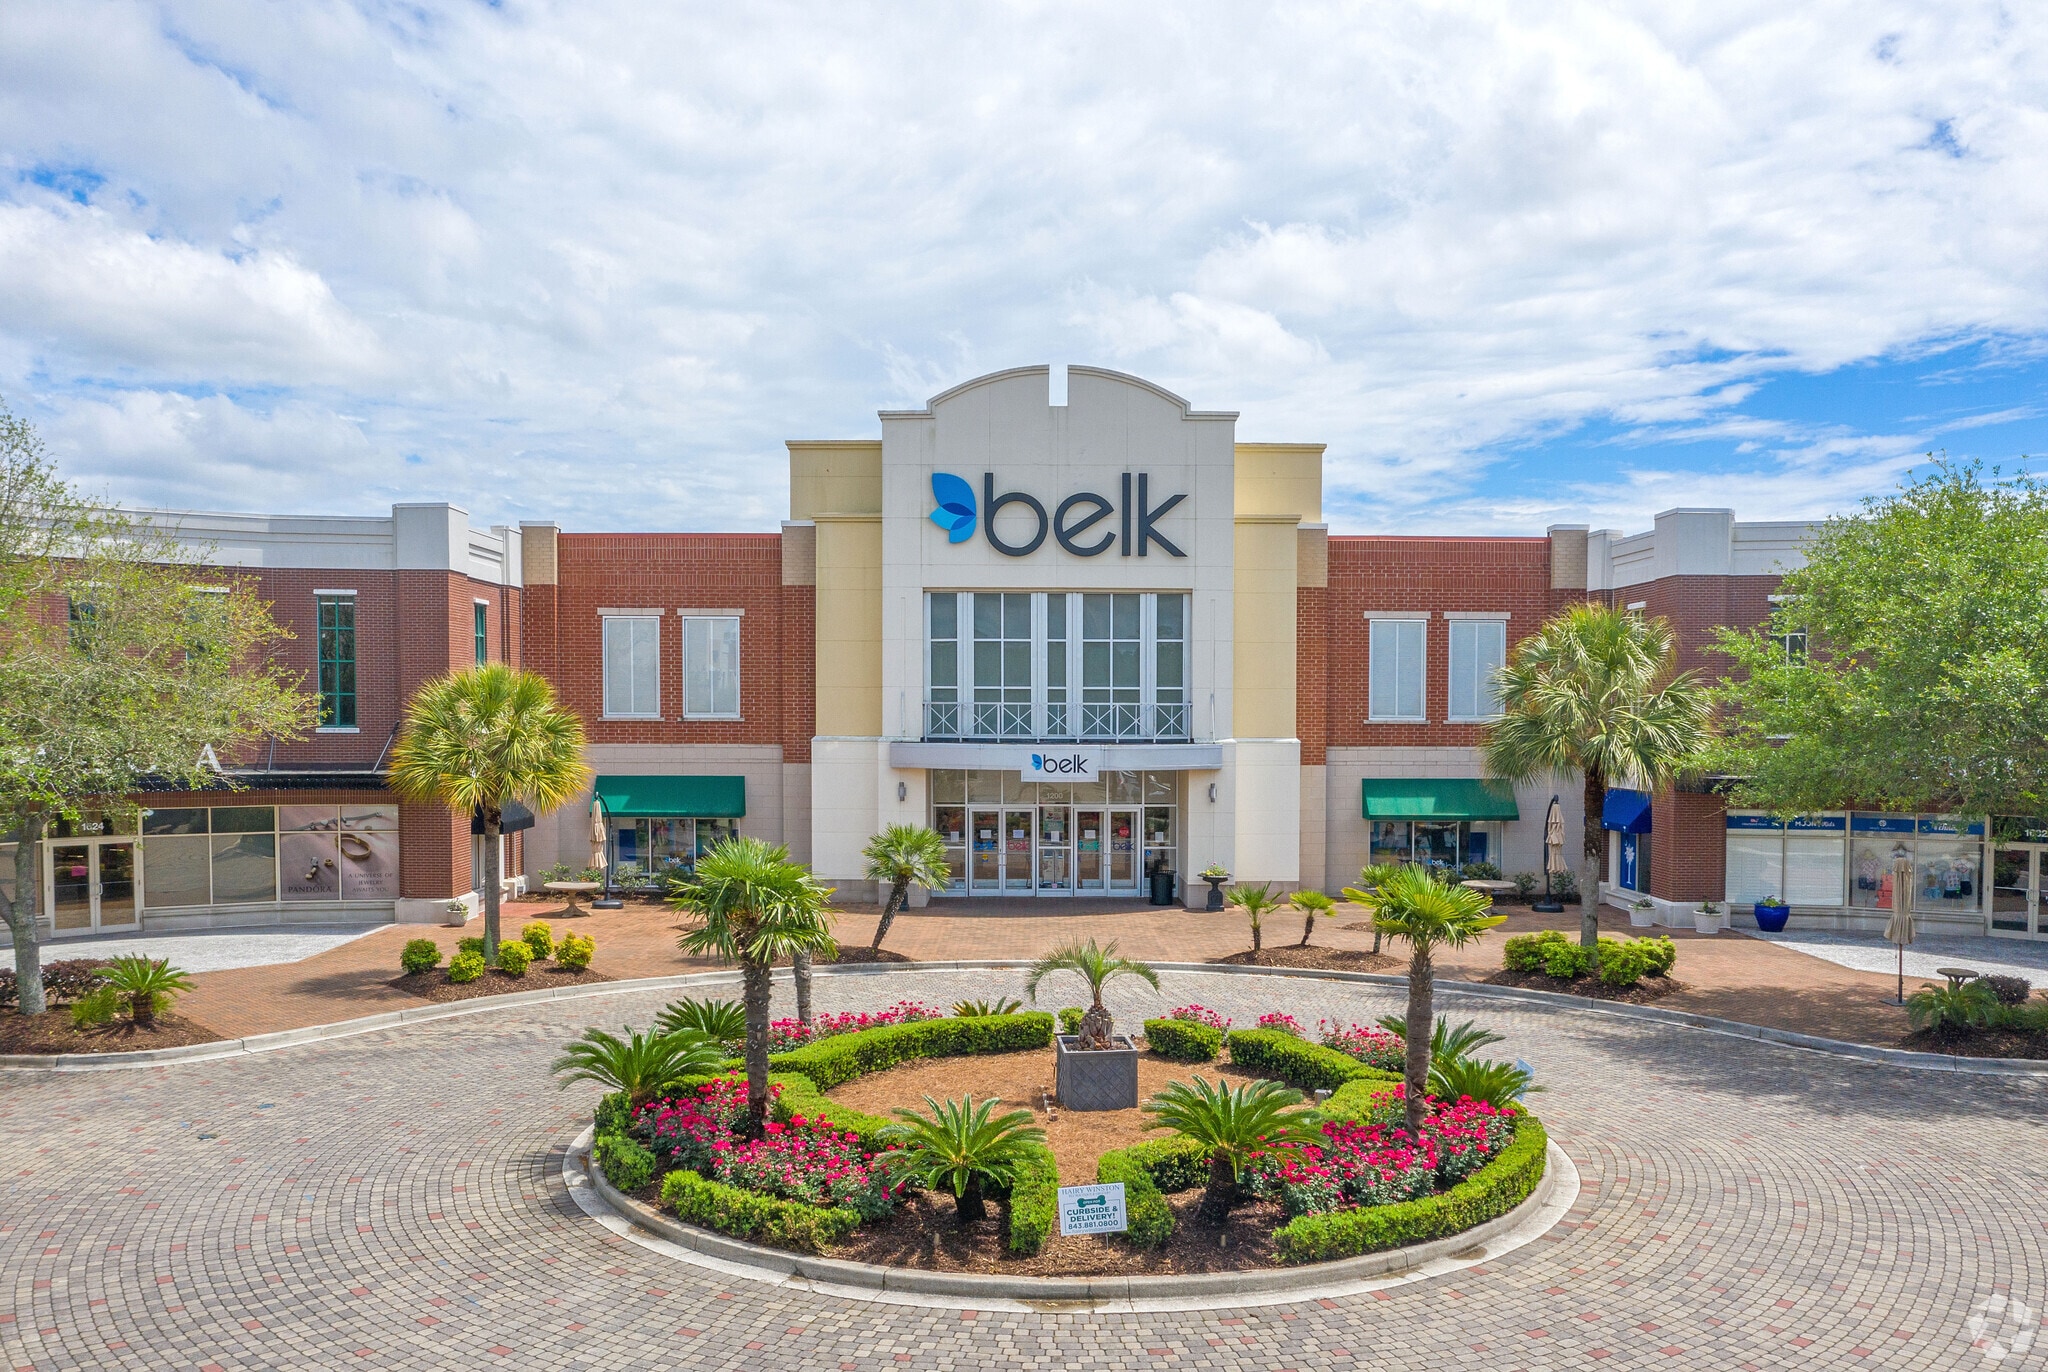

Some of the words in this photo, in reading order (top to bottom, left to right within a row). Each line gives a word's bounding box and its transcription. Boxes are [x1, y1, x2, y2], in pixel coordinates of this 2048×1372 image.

[983, 472, 1189, 558] belk
[1043, 753, 1089, 774] belk
[1007, 840, 1029, 851] belk
[1112, 840, 1135, 851] belk
[1061, 1187, 1085, 1195] HAIRY
[1086, 1184, 1120, 1193] WINSTON
[1067, 1207, 1110, 1216] CURBSIDE
[1070, 1212, 1116, 1222] DELIVERY!
[1068, 1219, 1119, 1230] 843.881.0800
